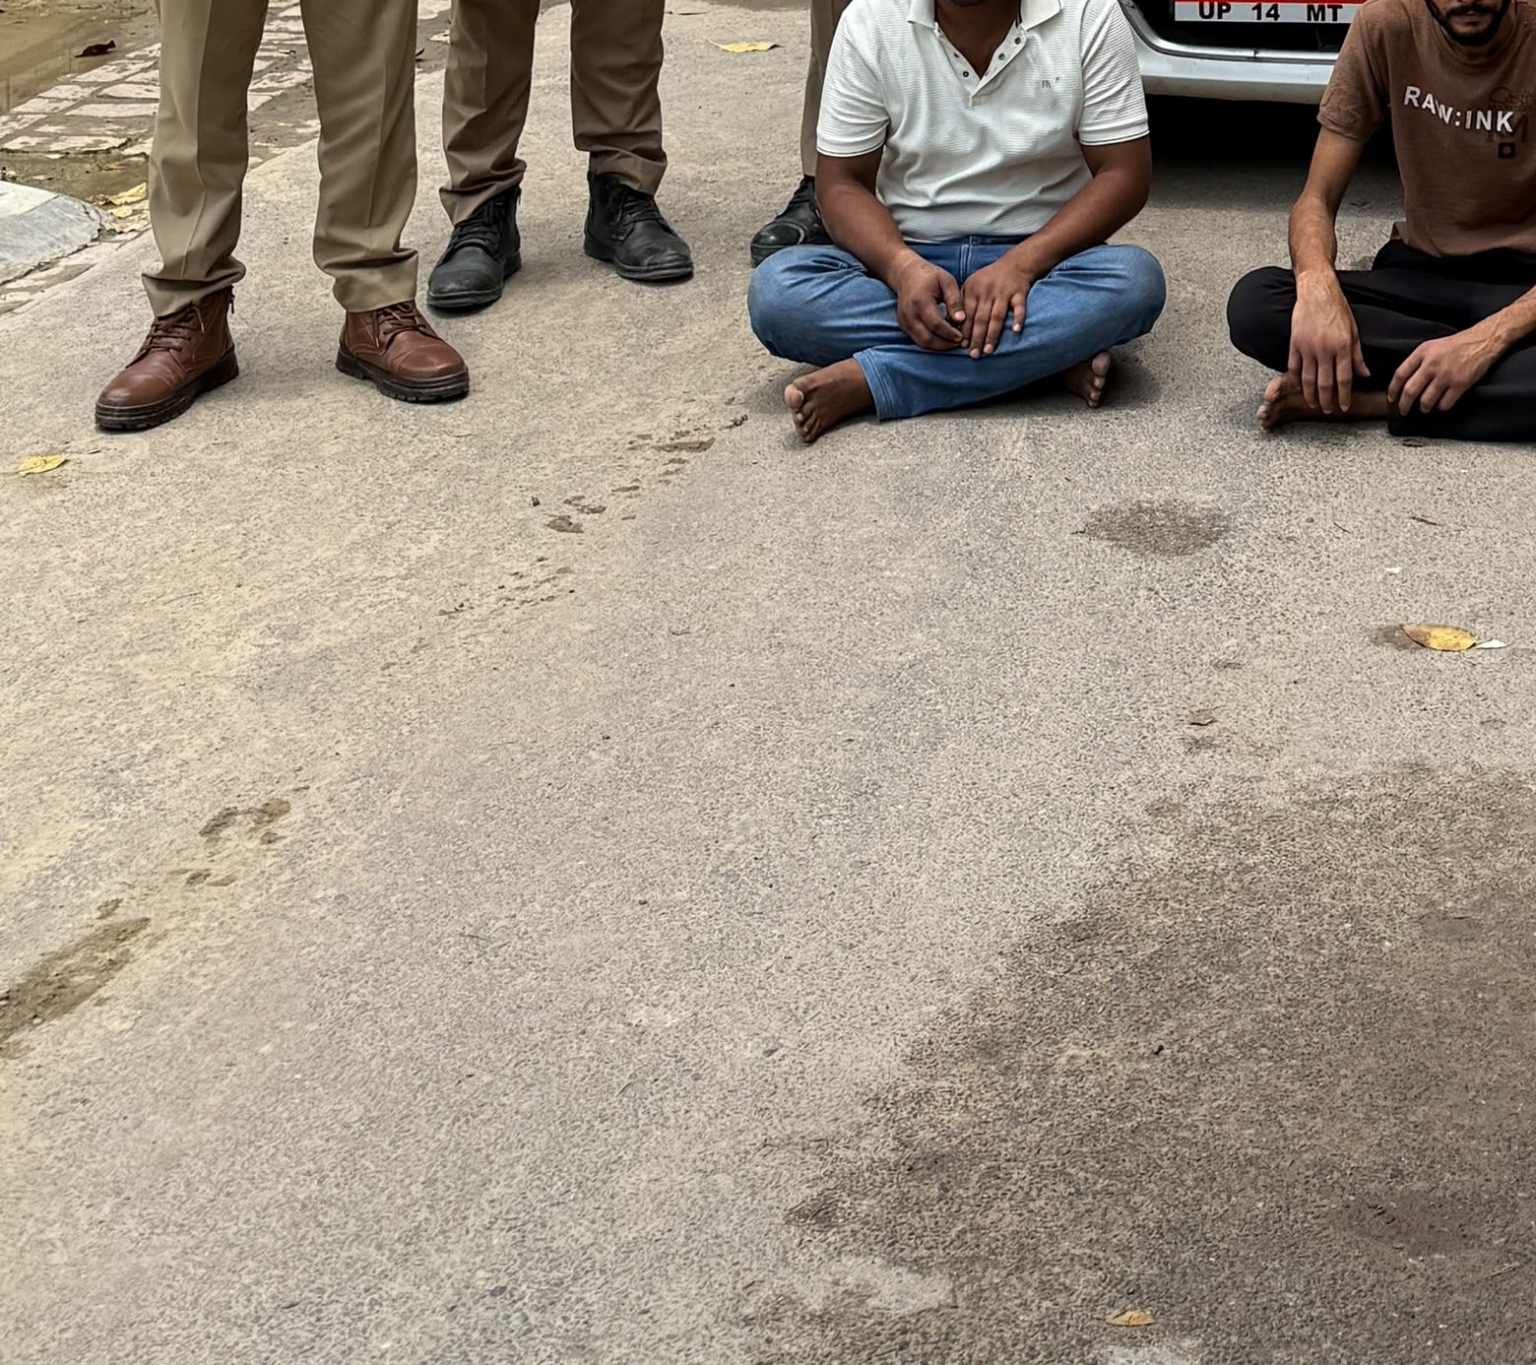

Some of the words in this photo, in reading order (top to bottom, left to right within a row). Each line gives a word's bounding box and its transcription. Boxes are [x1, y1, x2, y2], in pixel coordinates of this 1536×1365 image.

[1199, 2, 1232, 20] UP
[1252, 3, 1280, 21] 14
[1306, 4, 1343, 22] MT
